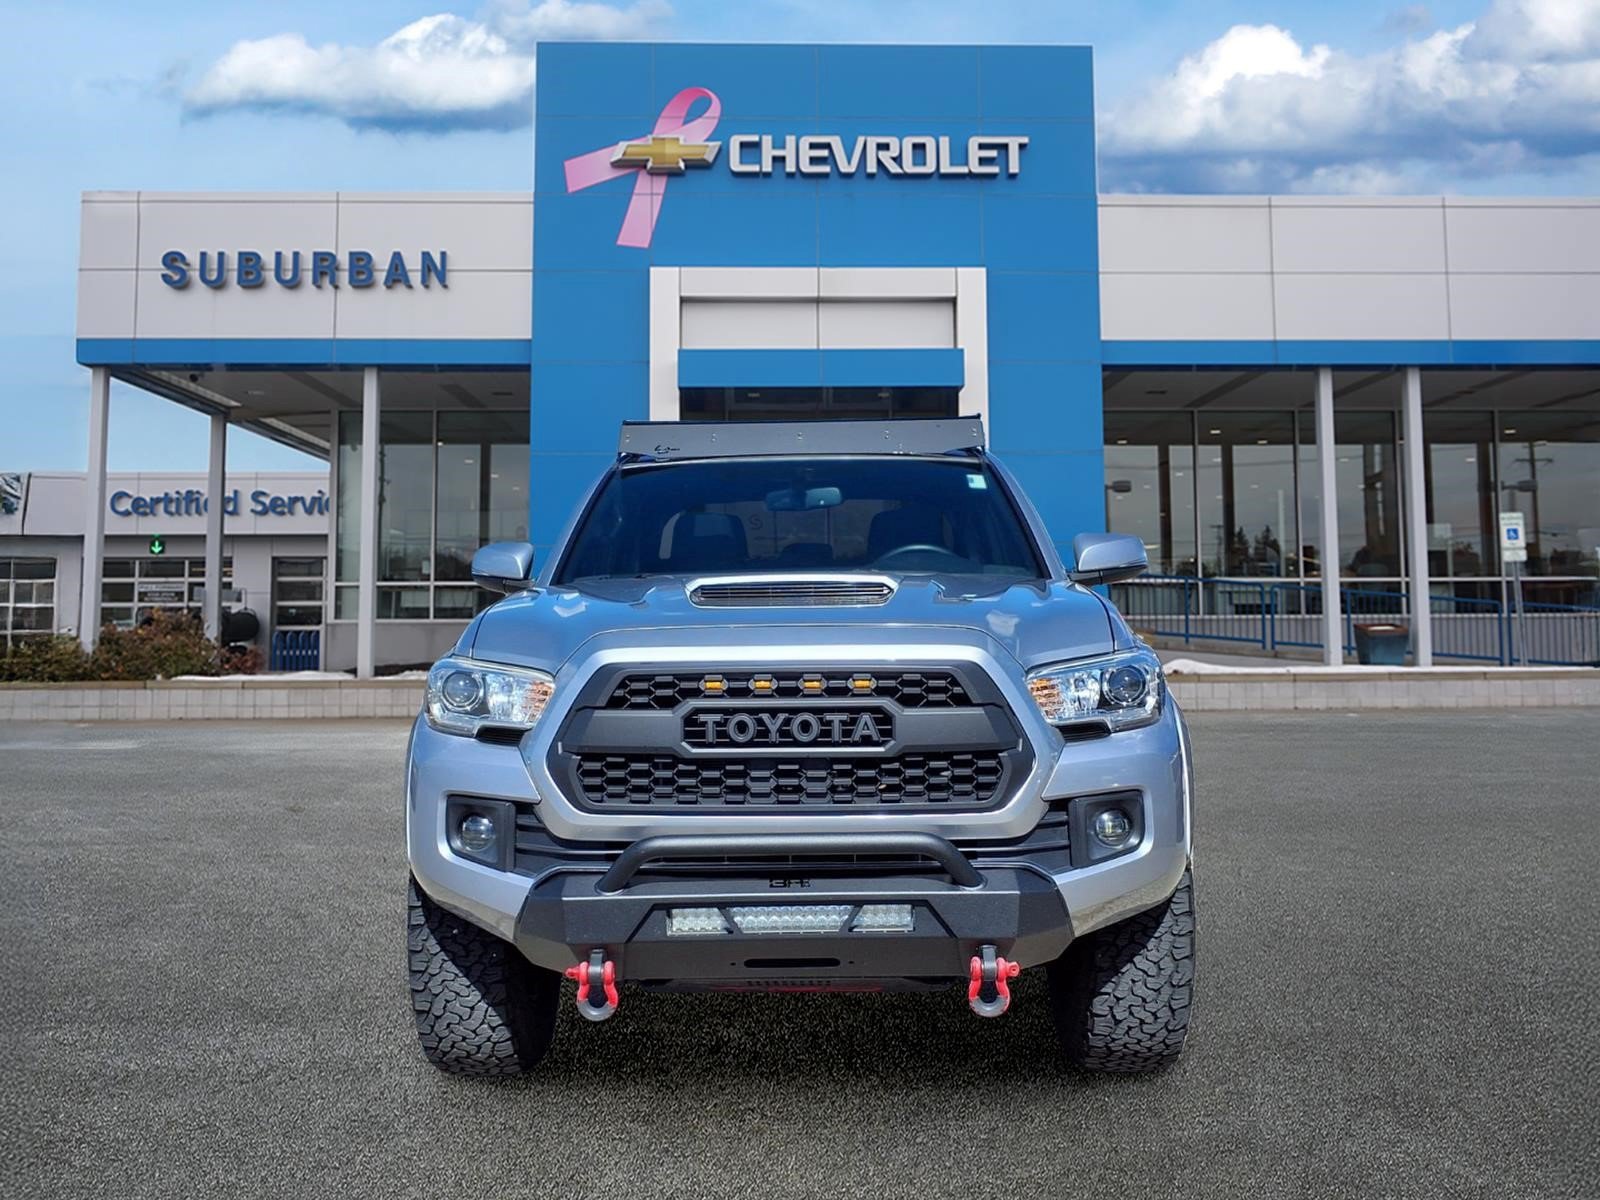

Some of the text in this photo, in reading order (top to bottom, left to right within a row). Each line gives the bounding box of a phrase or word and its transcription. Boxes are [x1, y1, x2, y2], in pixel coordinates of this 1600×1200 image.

[728, 133, 1029, 176] CHEVROLET
[161, 250, 449, 290] SUBURBAN
[249, 489, 330, 517] Servi
[697, 712, 882, 744] TOYOTA
